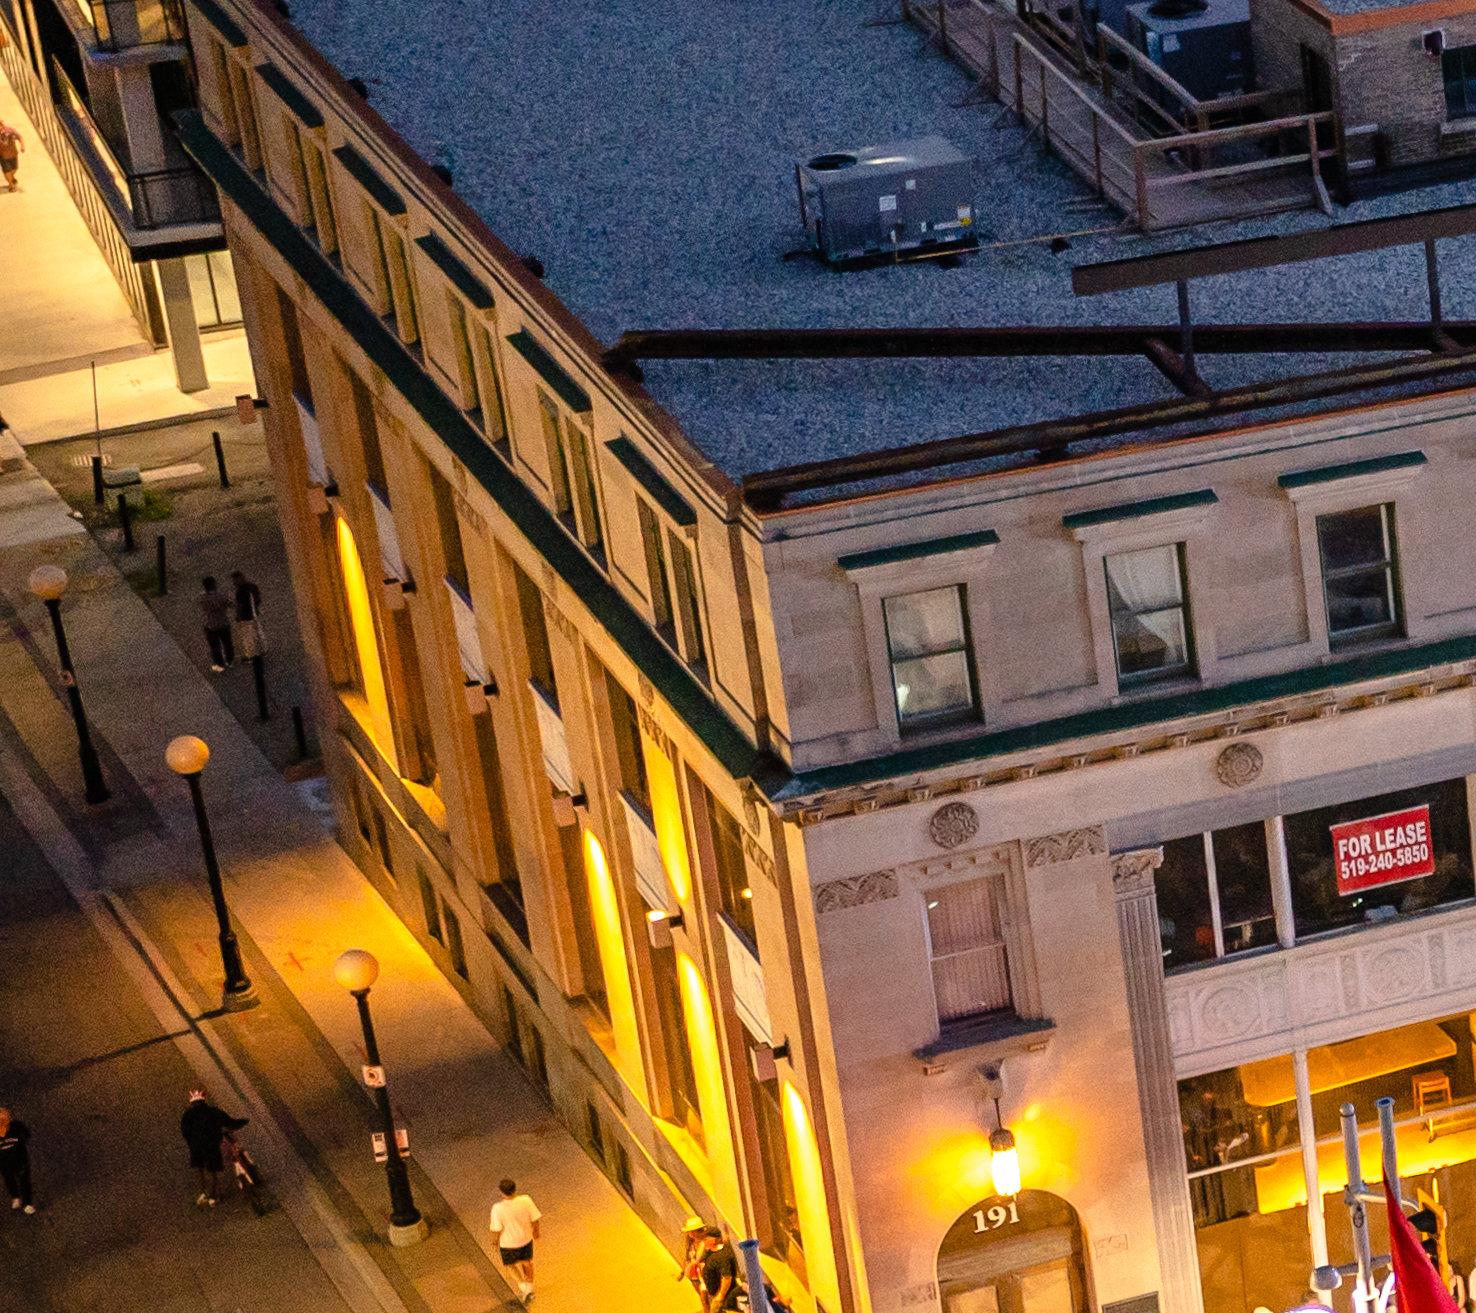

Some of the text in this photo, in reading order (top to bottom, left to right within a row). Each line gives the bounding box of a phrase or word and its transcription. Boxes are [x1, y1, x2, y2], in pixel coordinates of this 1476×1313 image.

[1338, 821, 1428, 860] FOR LEASE
[1341, 843, 1429, 880] 519-240-5850
[973, 1202, 1022, 1232] 191
